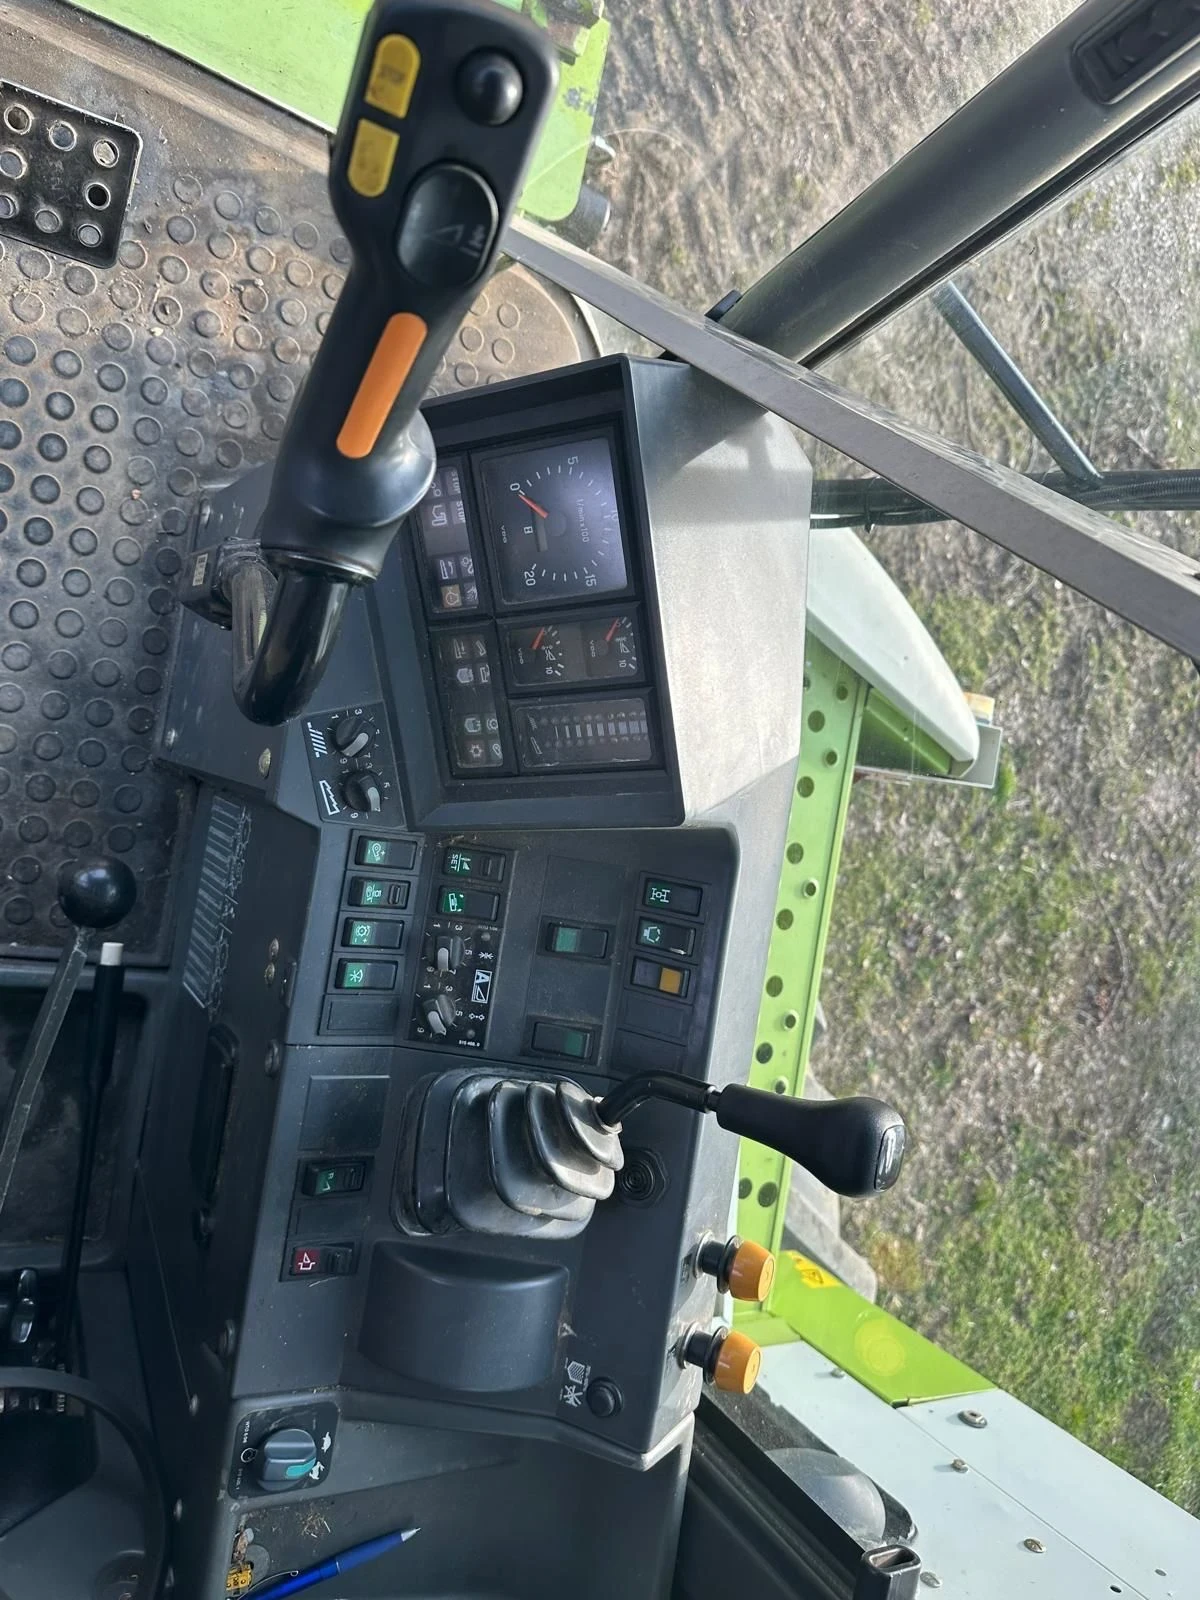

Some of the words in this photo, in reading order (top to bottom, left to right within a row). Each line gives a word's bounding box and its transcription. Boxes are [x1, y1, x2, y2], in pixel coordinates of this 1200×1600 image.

[568, 456, 578, 465] 5
[451, 472, 461, 493] STOP
[456, 501, 465, 523] STOP
[524, 571, 535, 586] 20
[585, 574, 596, 587] 15
[450, 854, 458, 871] SET
[477, 972, 489, 984] A
